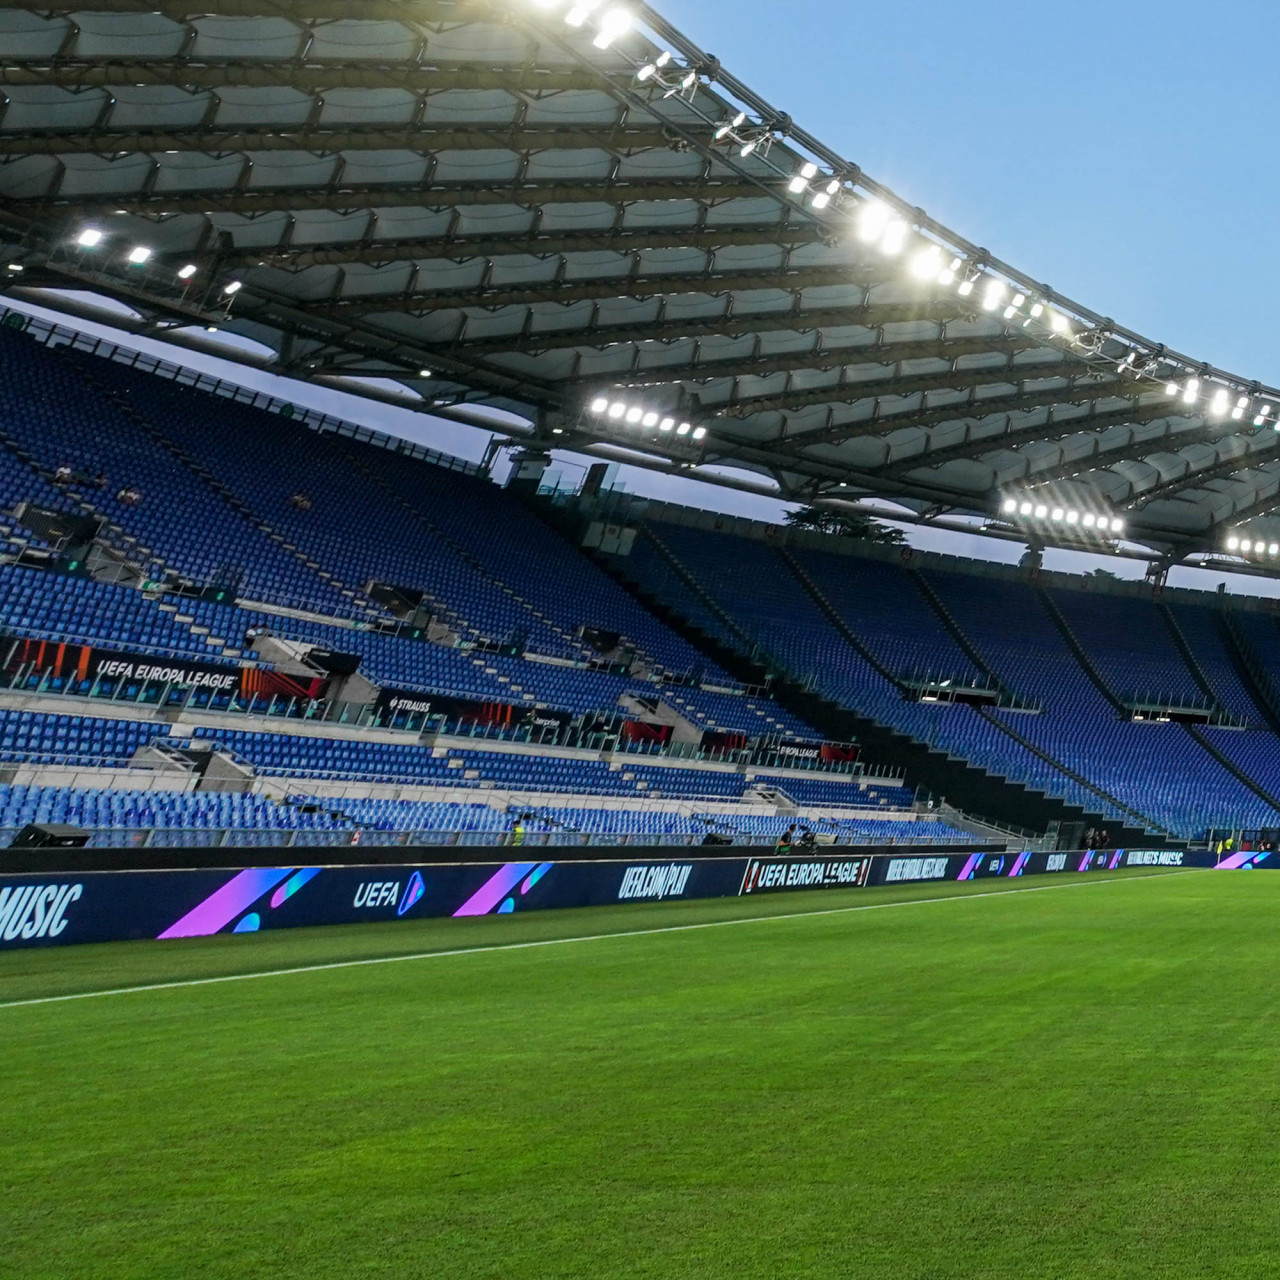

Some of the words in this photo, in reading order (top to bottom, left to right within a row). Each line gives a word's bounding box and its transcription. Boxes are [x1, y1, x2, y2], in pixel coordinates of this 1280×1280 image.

[97, 660, 134, 678] UEFA
[134, 667, 184, 683] EUROPA
[186, 671, 235, 689] LEAGUE
[397, 699, 431, 712] STRAUSS
[757, 864, 786, 888] UEFA
[786, 863, 825, 885] EUROPA
[823, 862, 860, 883] LEAGUE
[353, 881, 400, 908] UEFA
